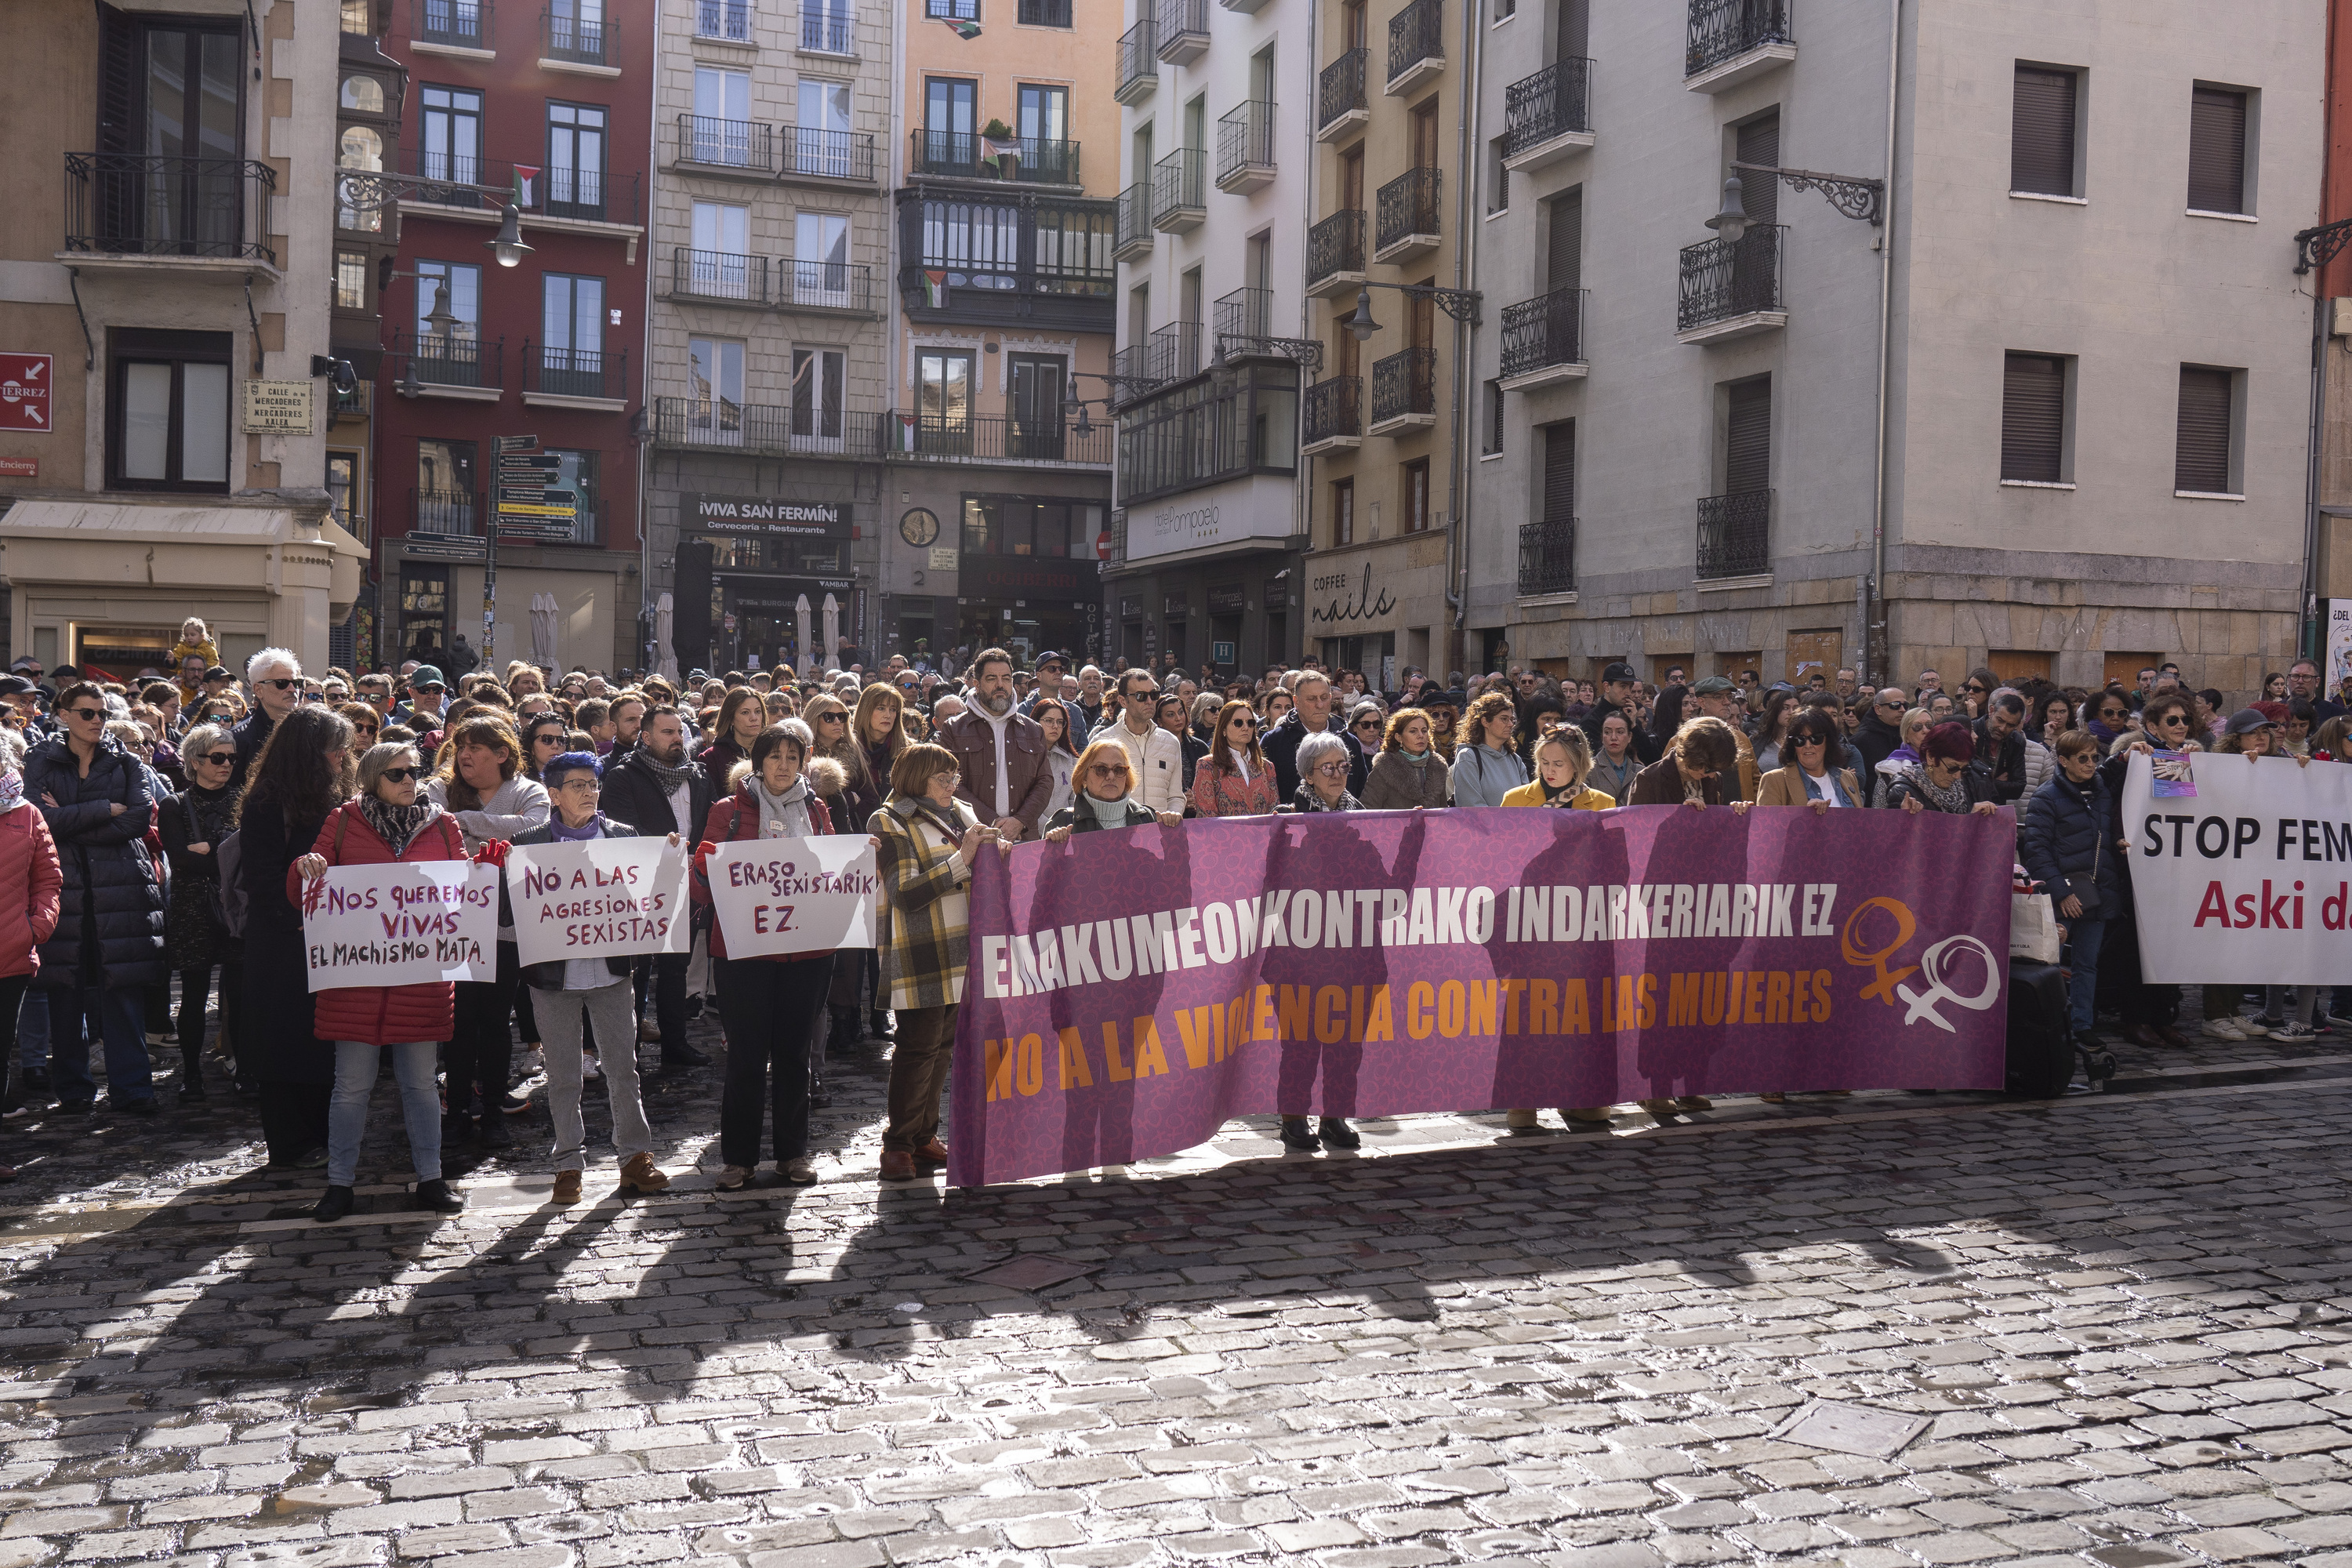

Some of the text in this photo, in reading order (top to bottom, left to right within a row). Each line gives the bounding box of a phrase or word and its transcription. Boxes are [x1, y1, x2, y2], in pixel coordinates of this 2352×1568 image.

[0, 386, 46, 397] IERREZ
[255, 397, 302, 406] MERCADERES
[254, 409, 303, 418] MERCADERES
[265, 418, 289, 426] KALEA
[0, 460, 35, 470] Encierro
[699, 501, 837, 522] ¡VIVA SAN FERMÍN!
[1155, 497, 1219, 539] Hotel Pompaelo
[707, 521, 760, 531] Cervecería
[768, 524, 826, 534] Restaurante
[913, 571, 924, 586] 2
[987, 572, 1077, 588] OGIBERRI
[1314, 574, 1345, 591] COFFEE
[1312, 562, 1396, 623] nails
[418, 596, 427, 608] 6
[2332, 610, 2350, 621] ¿DEL
[1219, 644, 1229, 657] H
[2143, 813, 2352, 862] STOP FEM
[570, 868, 587, 890] A
[595, 866, 640, 887] LAS
[728, 861, 796, 887] ERASO
[2193, 879, 2352, 931] Aski d
[1261, 887, 1495, 949] KONTRAKO
[1505, 883, 1796, 942] INDARKERIARIK
[1802, 883, 1838, 937] EZ
[310, 943, 328, 969] EL
[984, 968, 1832, 1102] NO A LA VIOLENCIA CONTRA LAS MUJERES
